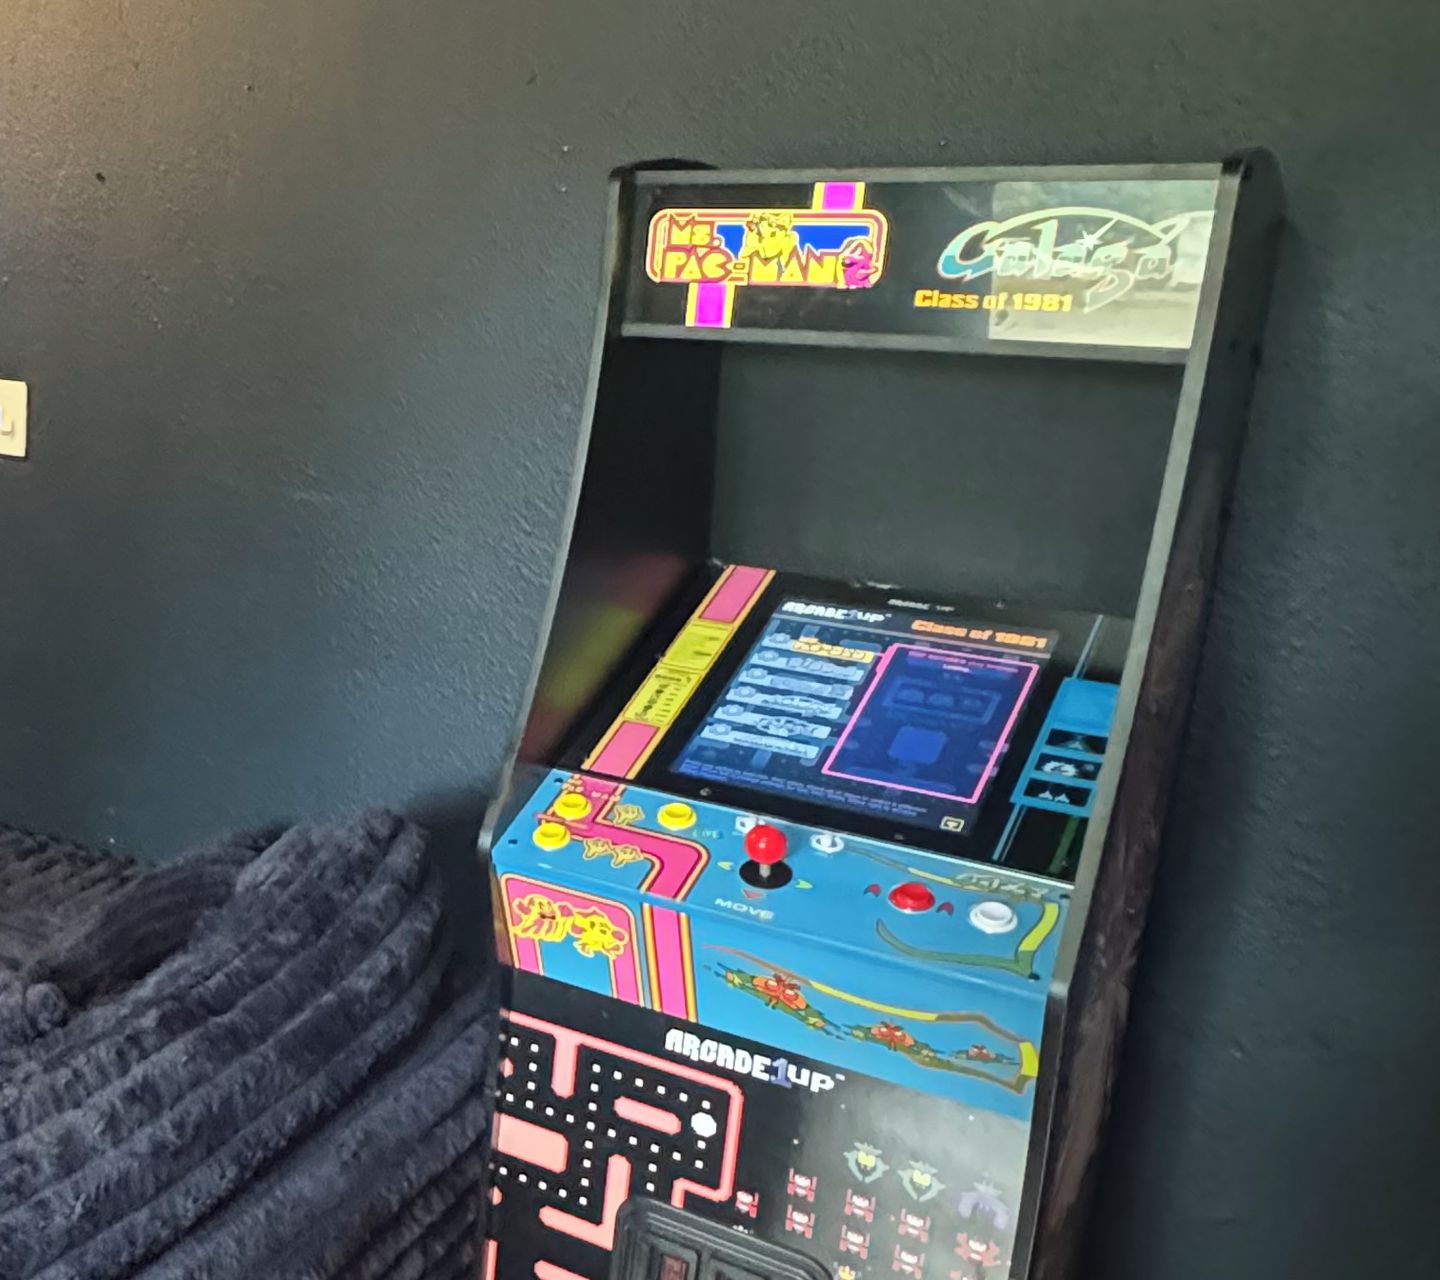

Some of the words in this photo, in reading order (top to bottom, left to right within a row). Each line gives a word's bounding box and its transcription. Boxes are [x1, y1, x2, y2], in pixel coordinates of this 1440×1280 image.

[914, 289, 980, 310] Class
[983, 291, 1008, 310] of
[1012, 292, 1073, 313] 1981
